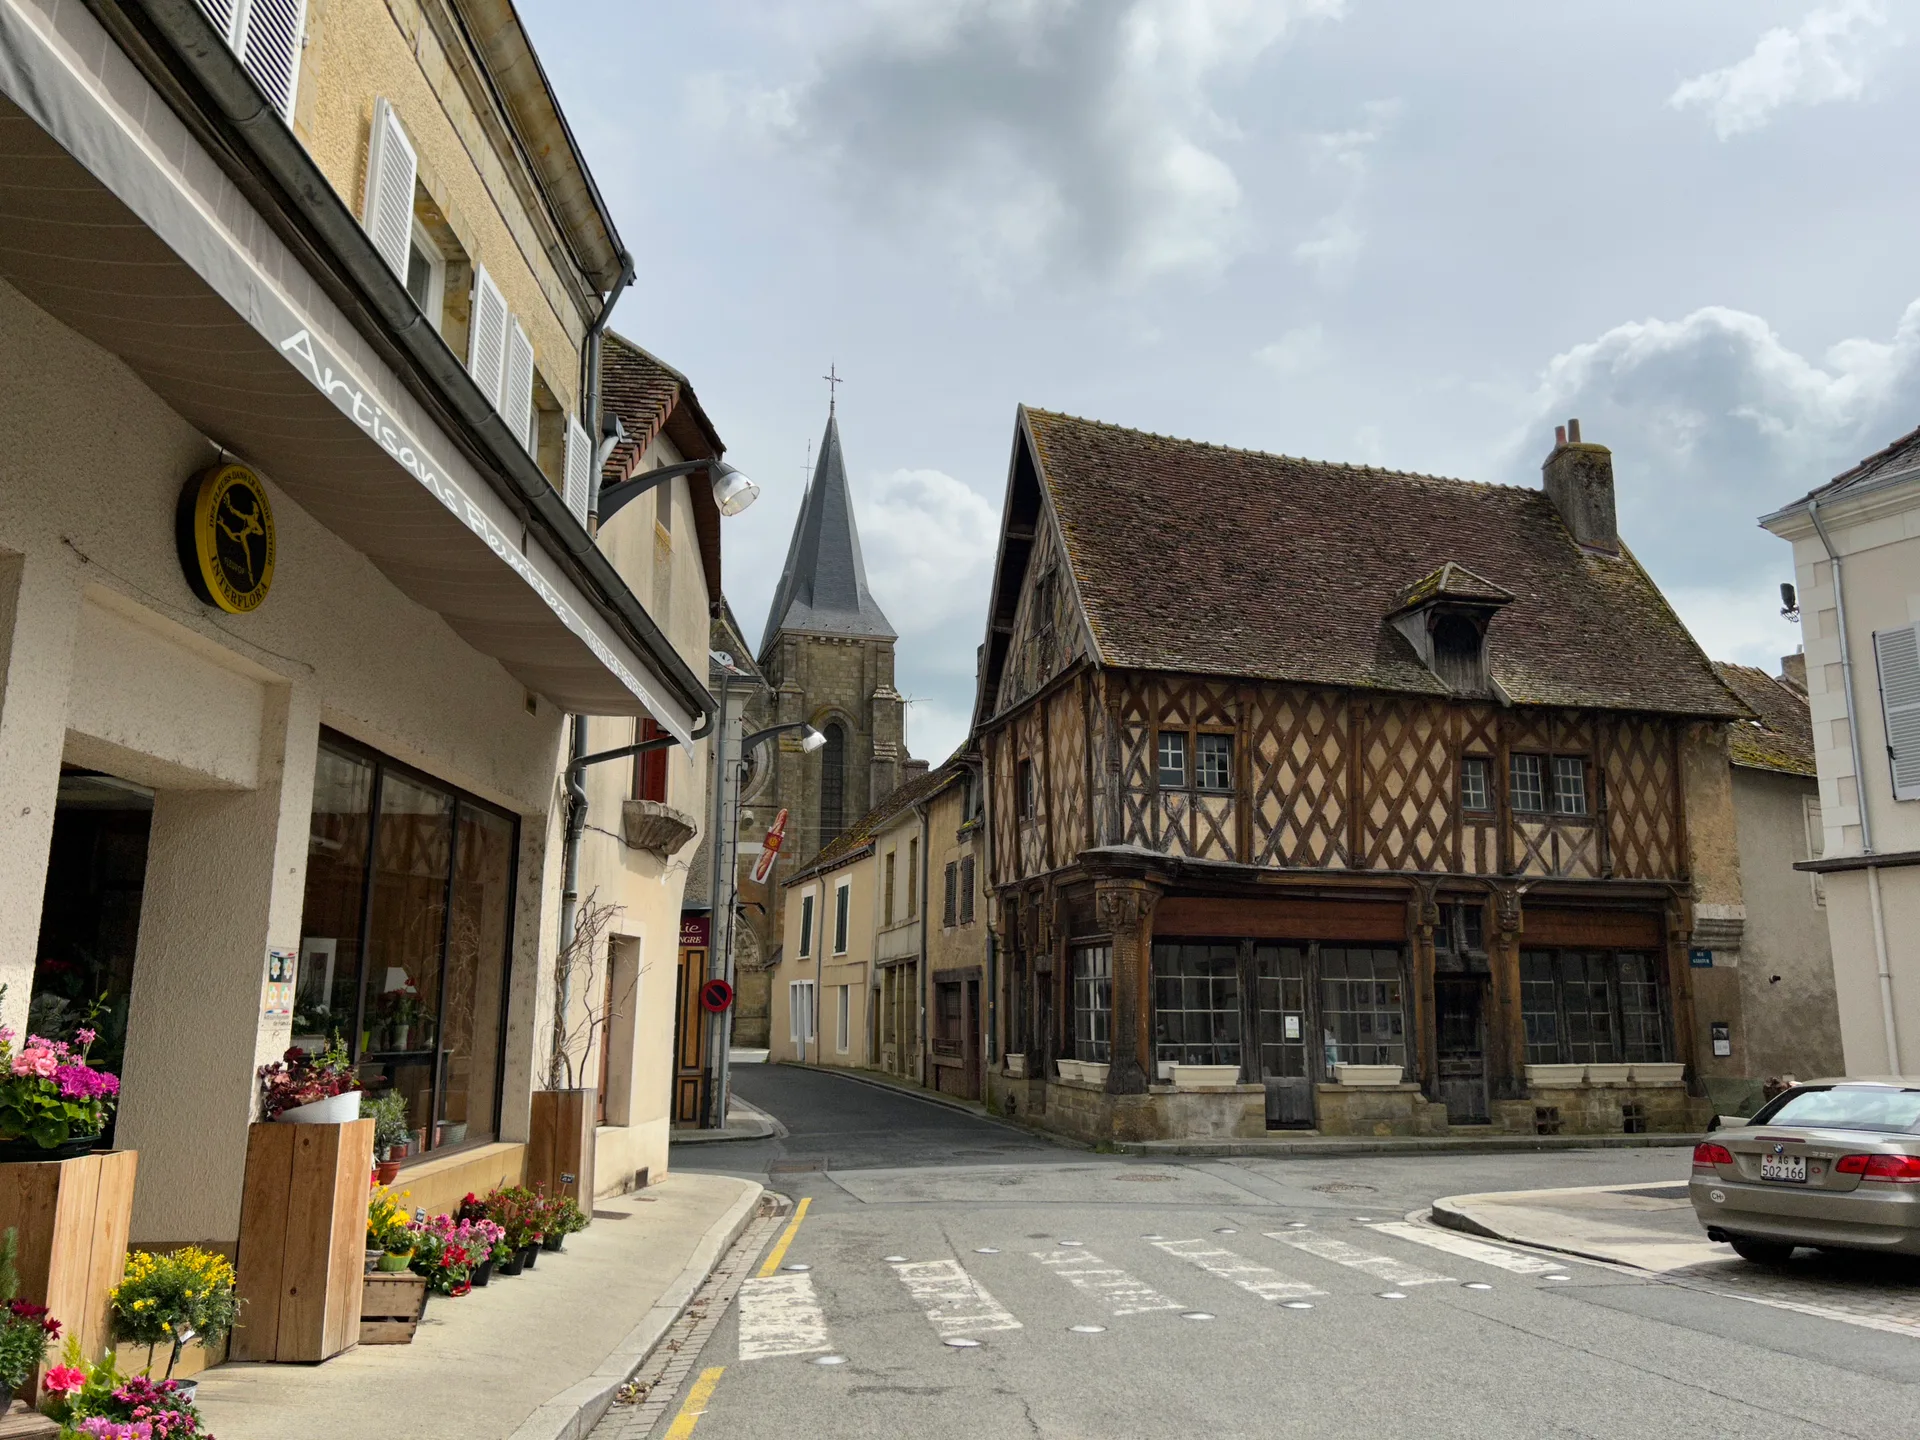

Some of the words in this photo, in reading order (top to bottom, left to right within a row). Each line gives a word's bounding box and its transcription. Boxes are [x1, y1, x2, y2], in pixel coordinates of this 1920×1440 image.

[280, 329, 458, 513] Artisans
[464, 499, 570, 624] Fleuristes
[211, 555, 268, 609] INTERFLORA
[1762, 1165, 1782, 1178] 502
[1785, 1167, 1804, 1179] 166
[1778, 1156, 1789, 1165] AG
